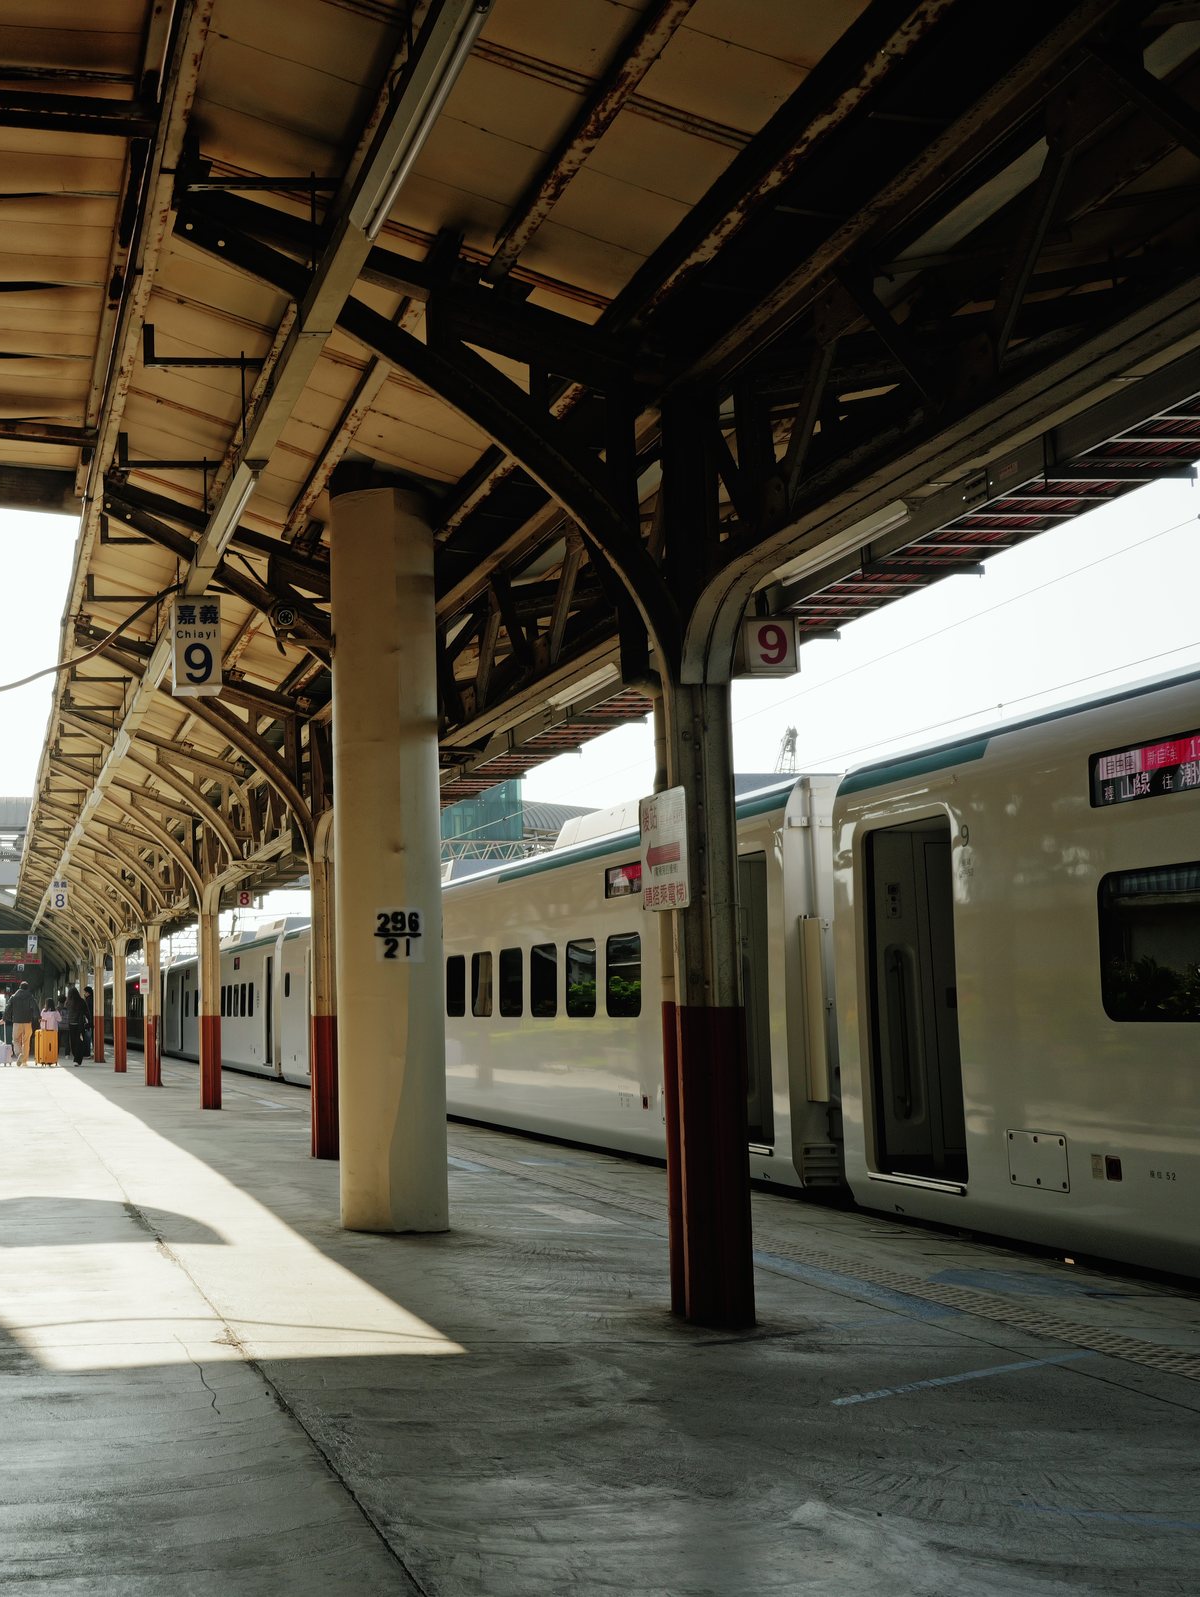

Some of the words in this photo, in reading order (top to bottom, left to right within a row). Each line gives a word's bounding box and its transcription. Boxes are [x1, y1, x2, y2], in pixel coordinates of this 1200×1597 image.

[177, 604, 219, 625] 嘉義
[176, 629, 217, 641] Chiayi
[757, 624, 788, 665] 9
[184, 642, 213, 684] 9
[1106, 757, 1135, 774] 自由座
[1120, 772, 1151, 798] 山線
[1162, 773, 1173, 790] 往
[961, 824, 969, 847] 9
[55, 893, 65, 908] 8
[240, 892, 249, 905] 8
[377, 911, 420, 933] 296
[29, 943, 35, 953] 7
[384, 938, 410, 959] 21
[1166, 1171, 1177, 1181] 52
